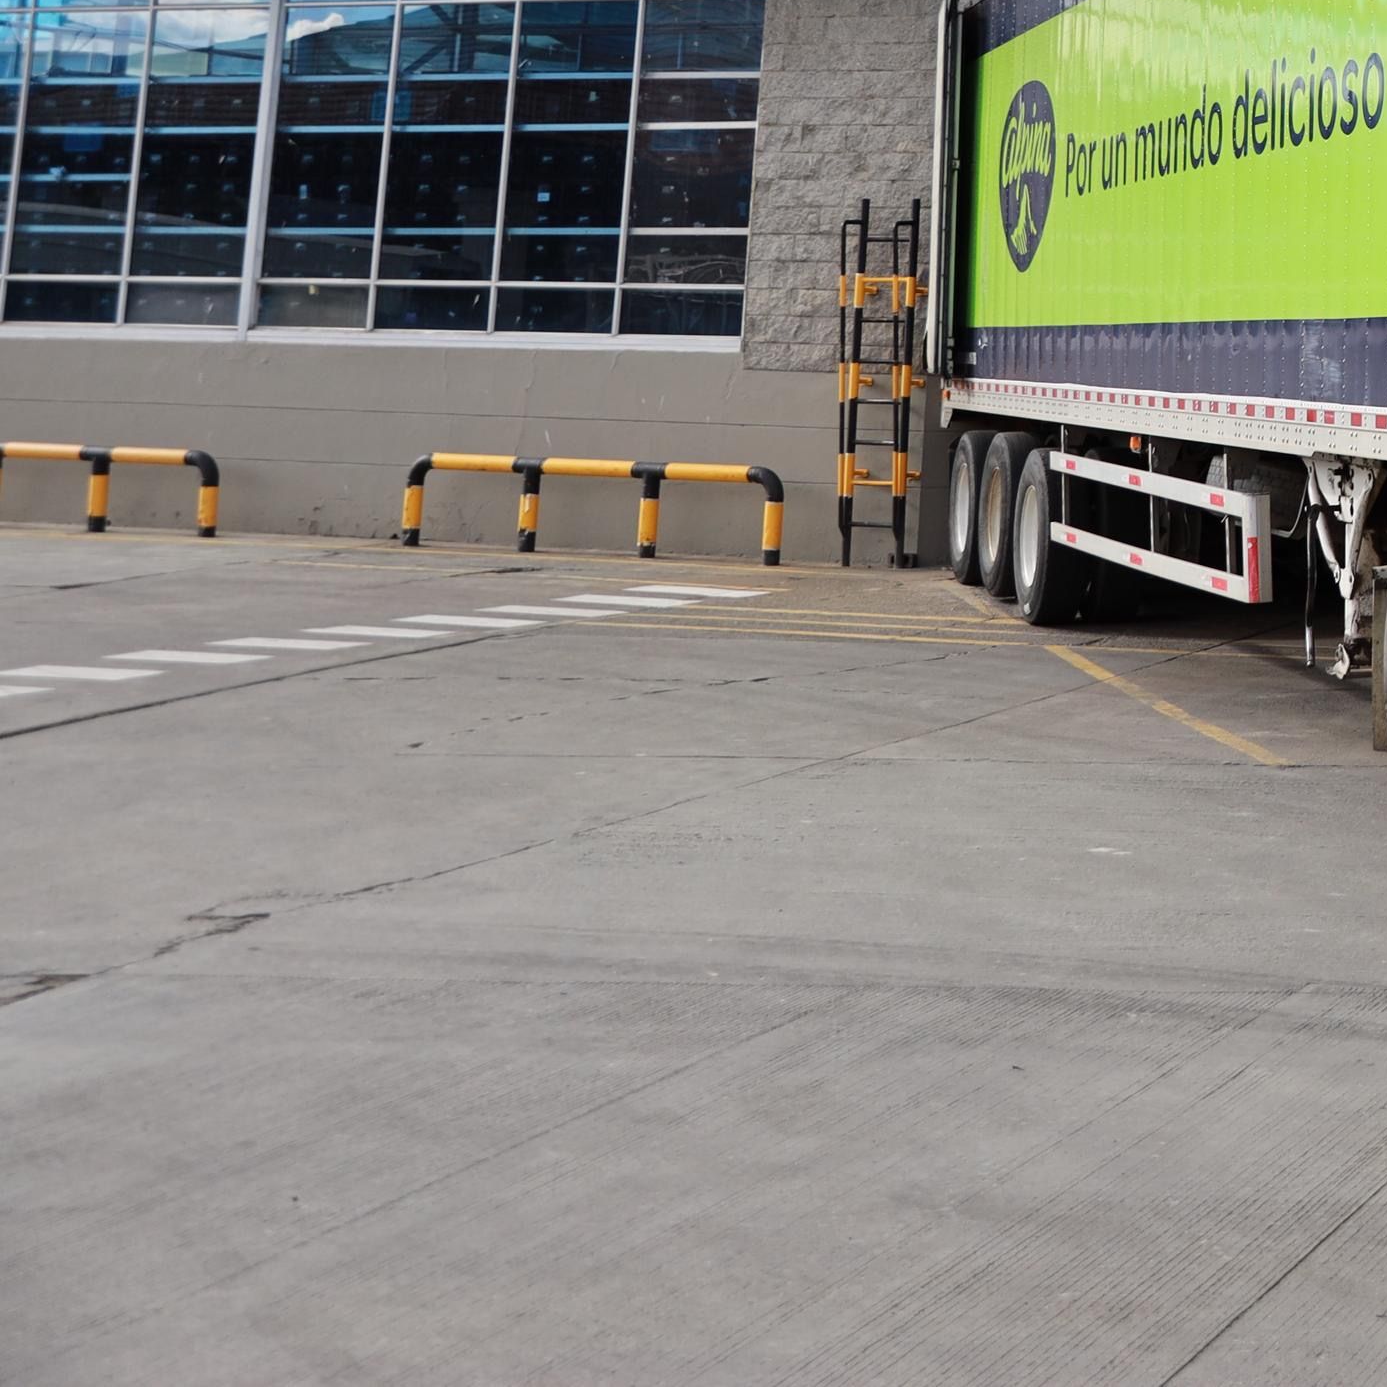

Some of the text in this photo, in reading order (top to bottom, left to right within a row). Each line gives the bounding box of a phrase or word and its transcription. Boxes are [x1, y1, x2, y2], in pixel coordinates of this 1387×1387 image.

[1001, 91, 1052, 200] alpina
[1065, 47, 1385, 198] Por un mundo delicioso
